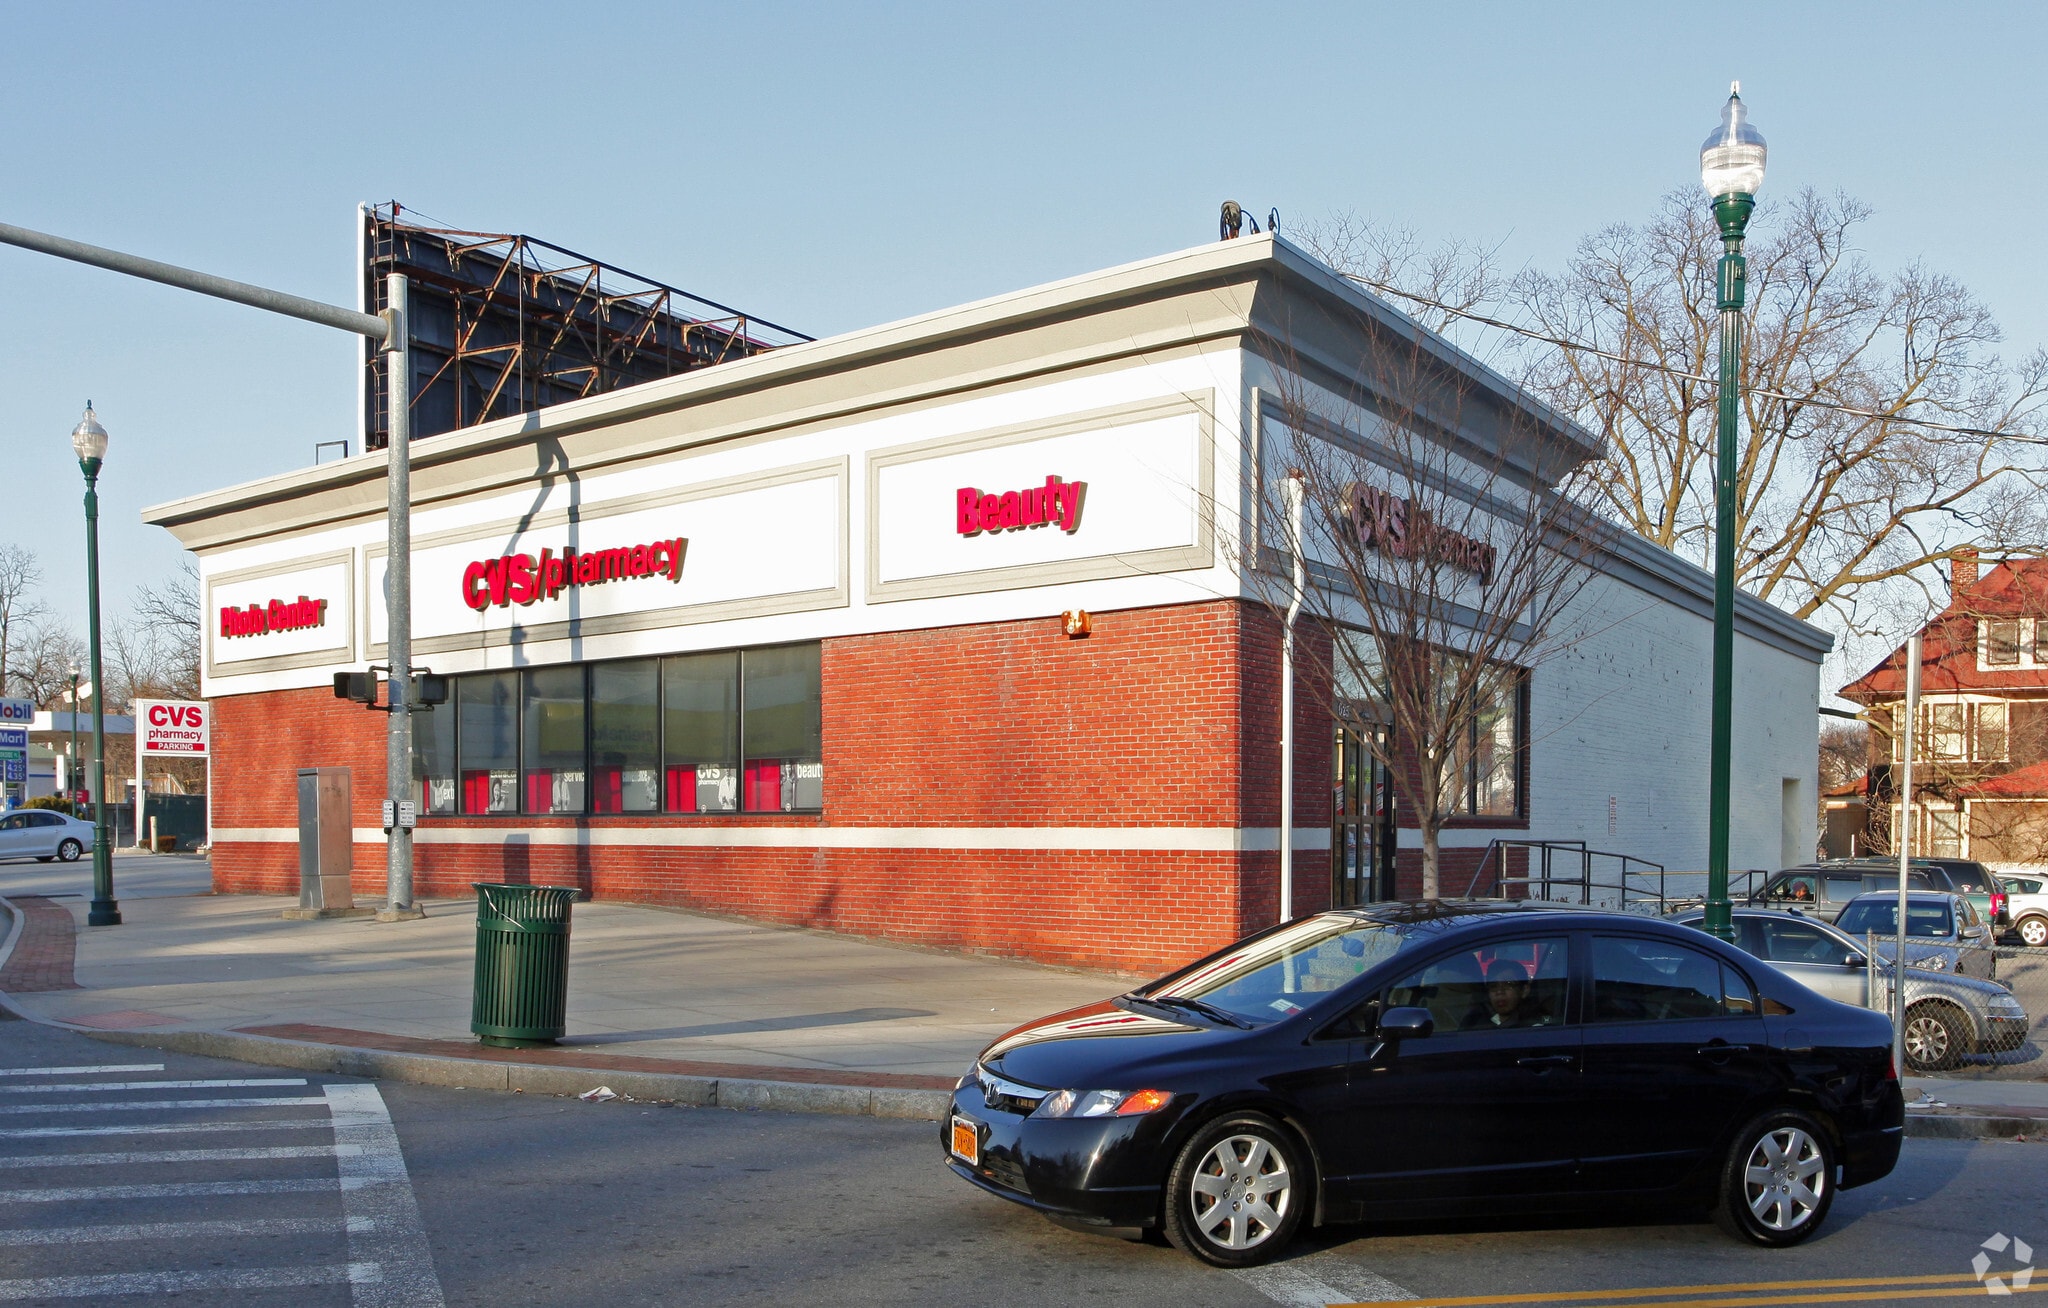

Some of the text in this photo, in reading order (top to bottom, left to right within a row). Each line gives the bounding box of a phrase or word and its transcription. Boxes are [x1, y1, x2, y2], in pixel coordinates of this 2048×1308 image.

[957, 475, 1087, 537] Beauty
[463, 537, 688, 611] CVS/pharmacy
[220, 595, 328, 640] Photo Center
[0, 703, 31, 719] obil
[148, 705, 203, 728] CVS
[148, 728, 203, 742] pharmacy
[158, 742, 194, 751] PARKING
[697, 763, 721, 779] CVS
